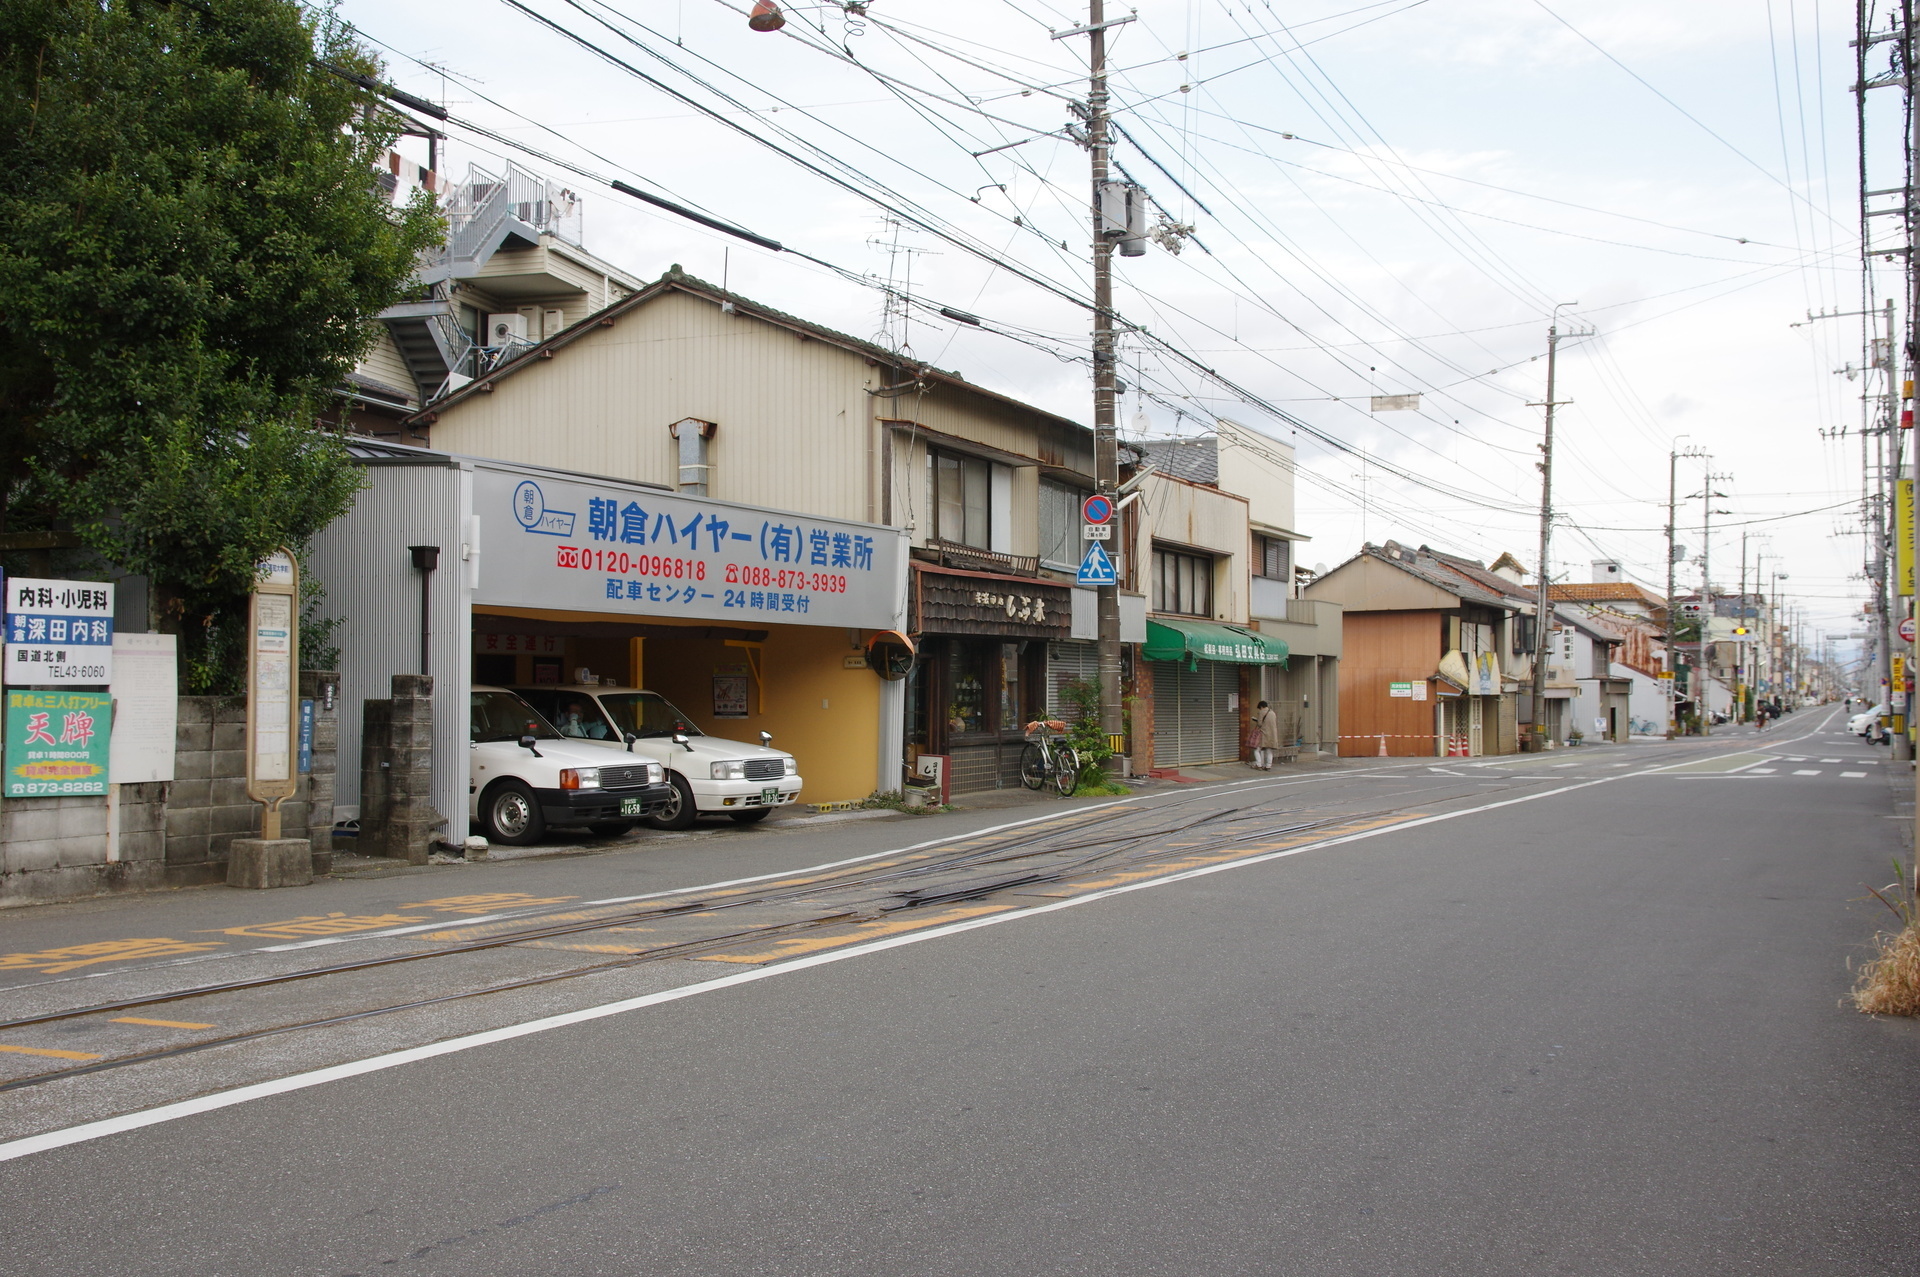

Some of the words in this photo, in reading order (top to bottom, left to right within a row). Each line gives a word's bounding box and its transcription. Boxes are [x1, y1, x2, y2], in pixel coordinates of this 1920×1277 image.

[524, 489, 534, 521] 朝倉
[541, 516, 571, 530] ハイヤー
[588, 497, 874, 571] 朝倉ハイヤー(有)営業所
[580, 549, 706, 581] 0120-096818
[742, 566, 847, 593] 088-873-3939
[19, 587, 107, 610] 内科・小児科
[606, 579, 715, 601] 配車センター
[723, 588, 810, 614] 24時間受付
[14, 615, 26, 641] 朝倉
[28, 619, 107, 642] 深田内科
[17, 649, 67, 662] 国道北側
[48, 665, 105, 678] TEL43-6060
[24, 711, 94, 748] 天牌
[26, 782, 103, 793] 873-8262
